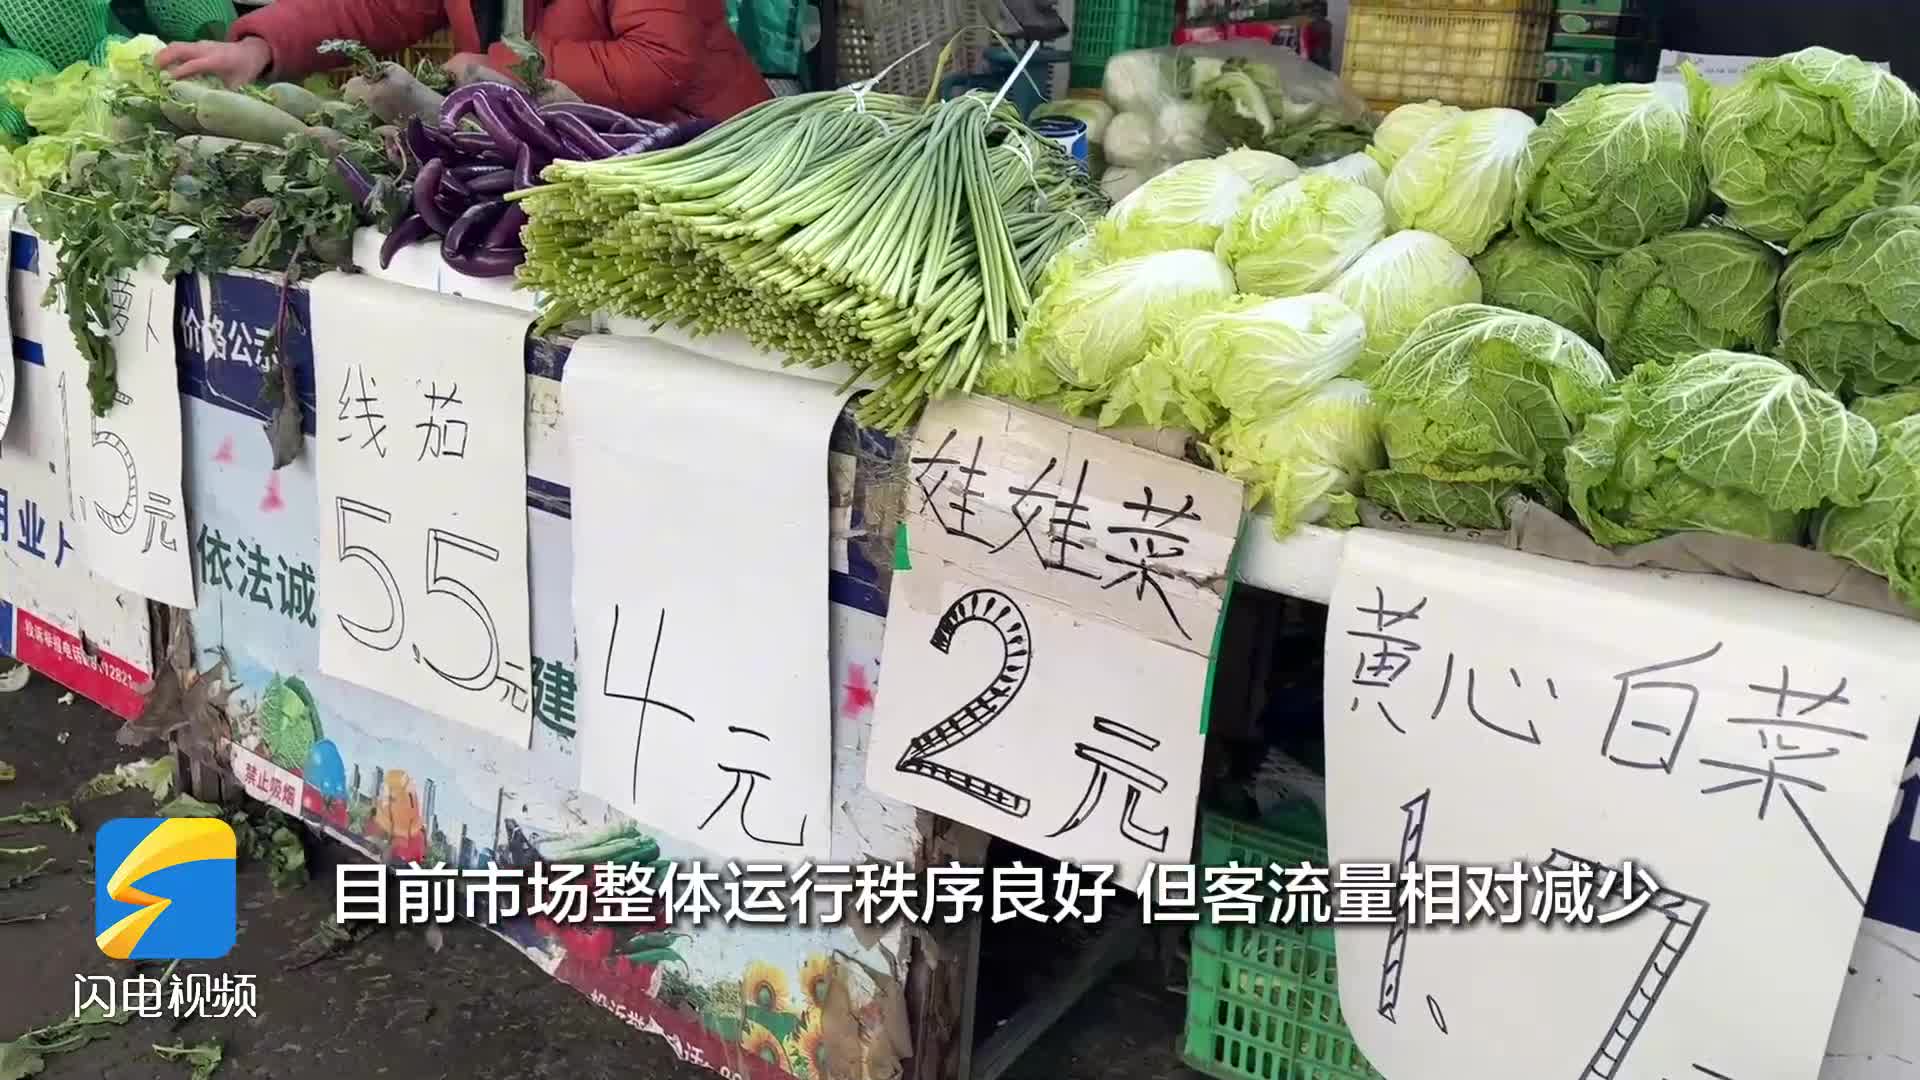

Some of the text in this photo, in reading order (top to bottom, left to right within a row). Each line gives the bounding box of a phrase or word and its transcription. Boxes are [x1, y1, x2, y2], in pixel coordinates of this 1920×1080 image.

[337, 364, 468, 461] 线茄
[197, 524, 316, 628] 依法诚
[336, 496, 529, 713] 5.5元
[911, 429, 1201, 640] 娃娃菜
[245, 763, 296, 808] 禁止吸烟
[603, 603, 808, 846] 4元
[896, 588, 1170, 853] 2元
[1347, 587, 1867, 908] 黄心白菜
[1379, 789, 1733, 1080] 1.7
